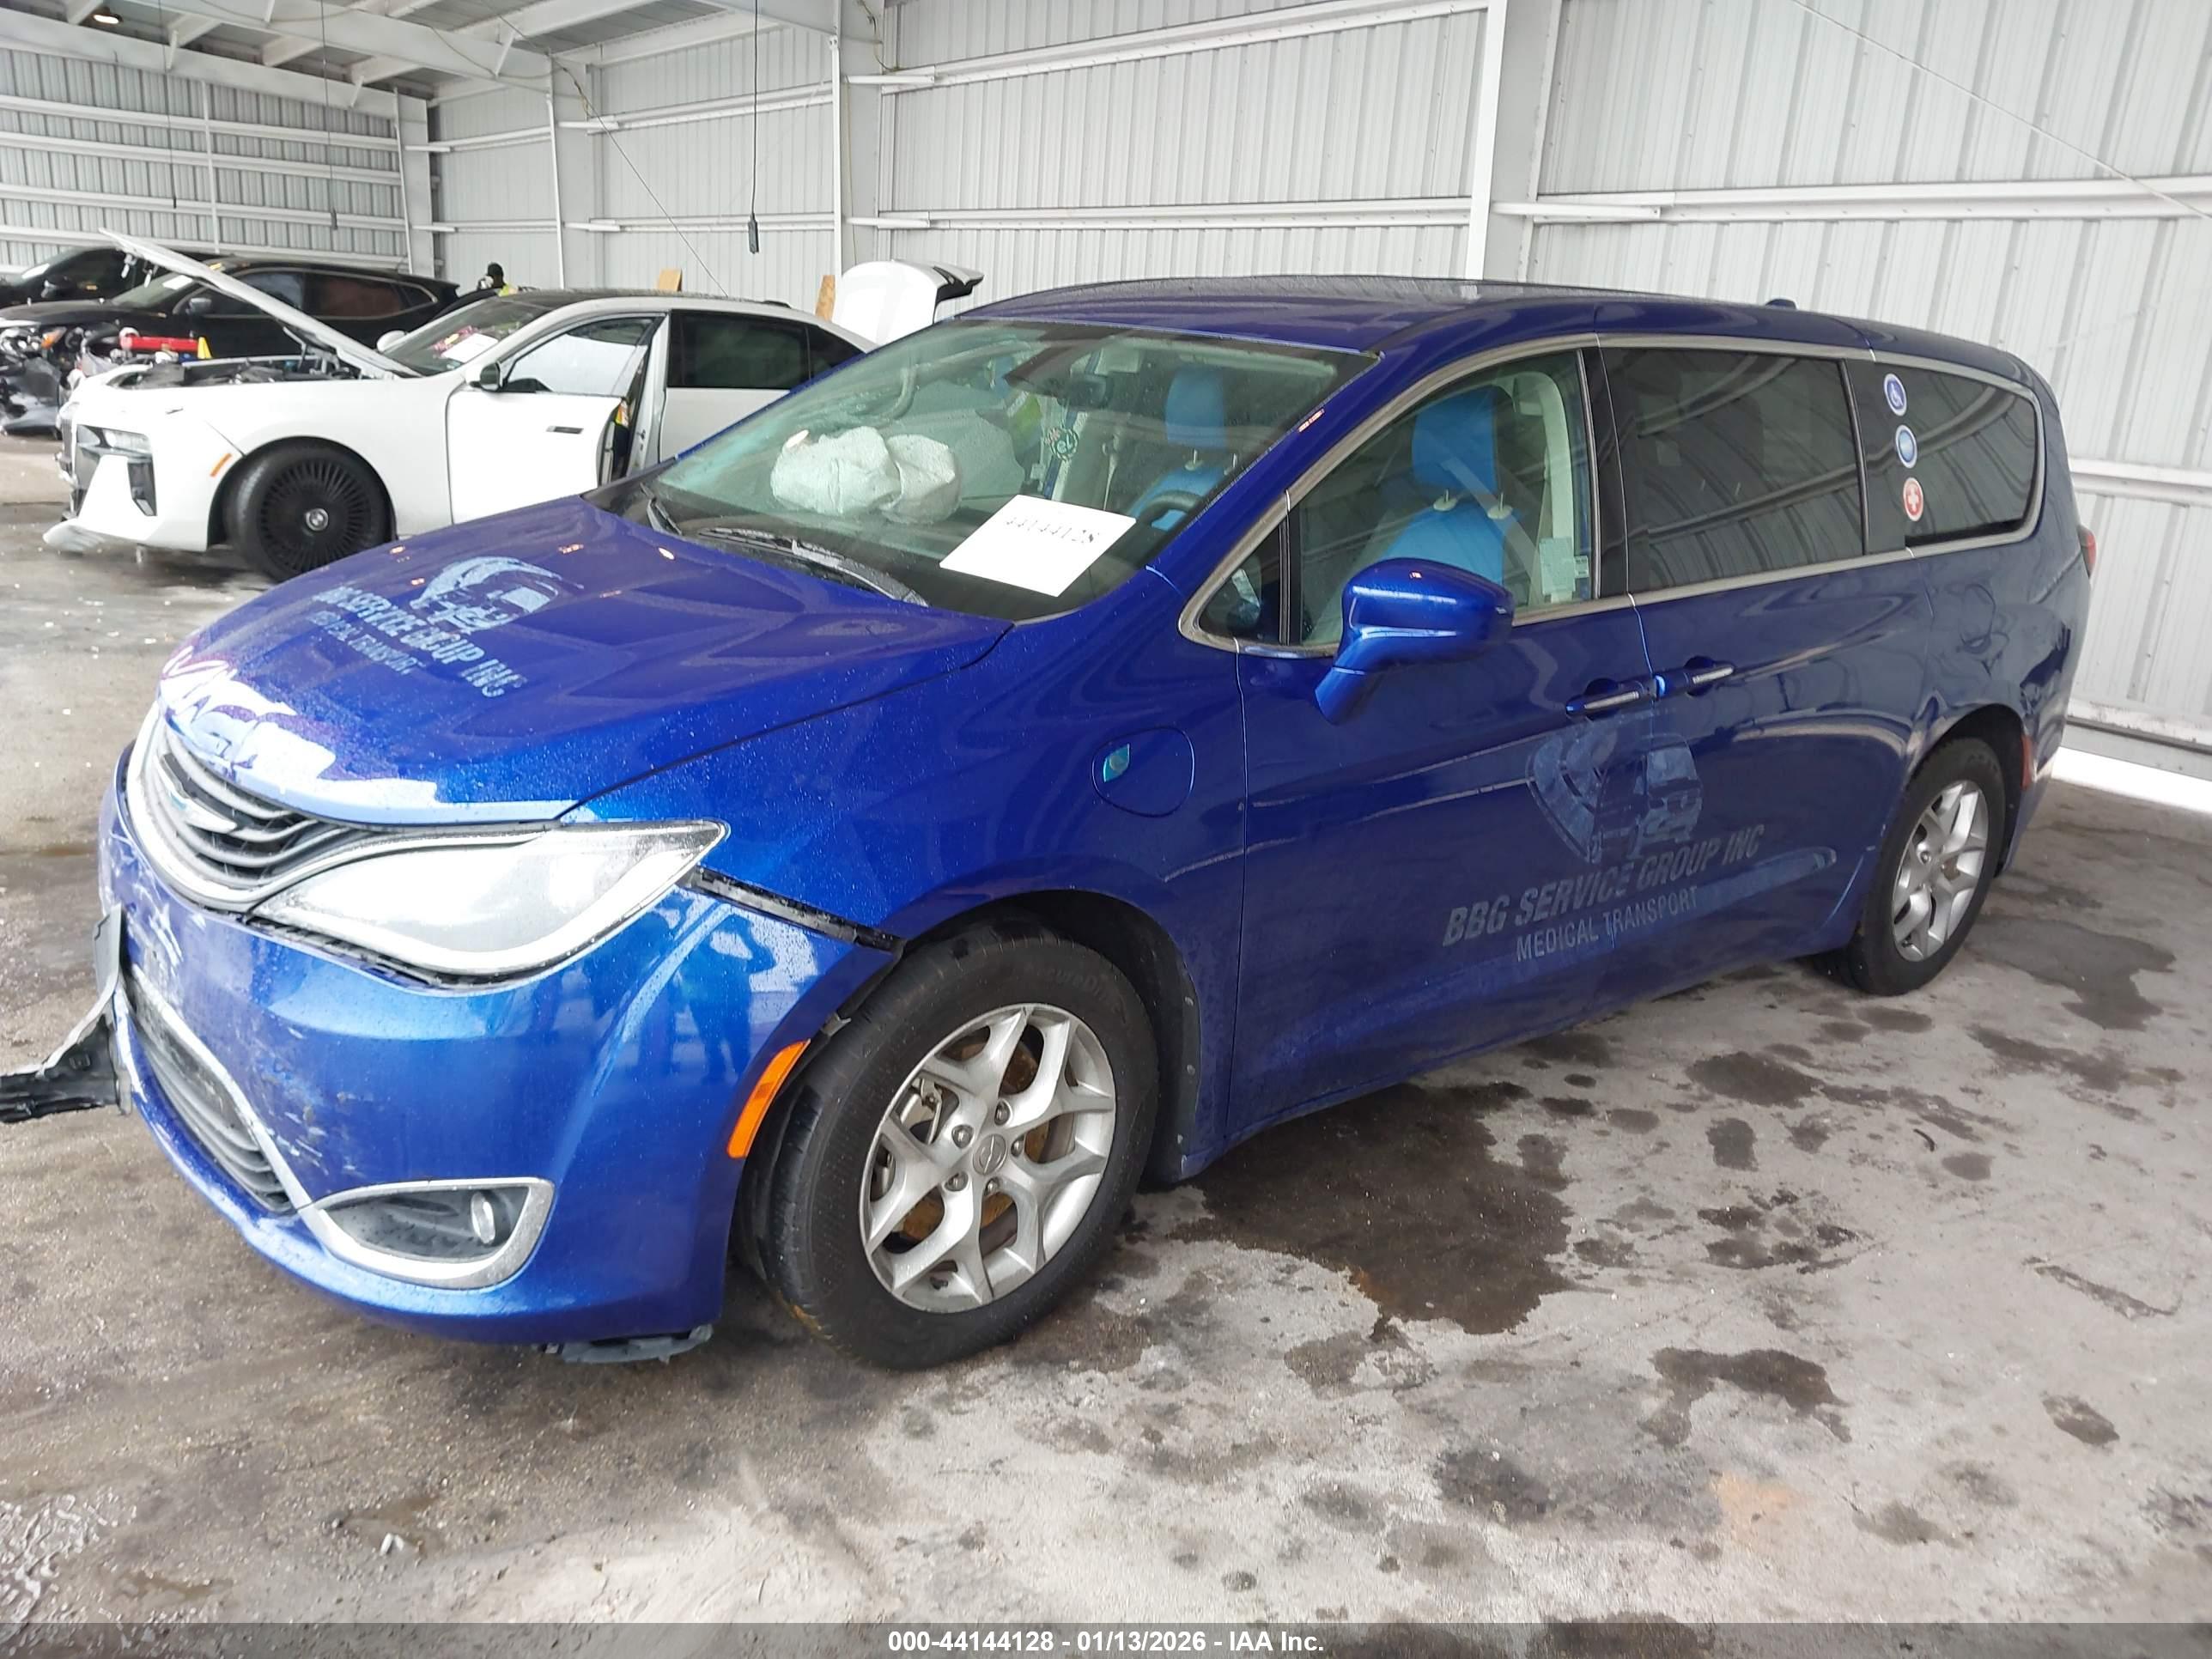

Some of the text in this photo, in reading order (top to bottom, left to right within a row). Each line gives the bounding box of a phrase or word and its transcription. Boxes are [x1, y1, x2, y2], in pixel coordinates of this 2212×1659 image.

[460, 659, 527, 697] INC
[1443, 824, 1765, 947] BBG SERVICE GROUP INC
[1516, 885, 1698, 963] MEDICAL TRANSPORT
